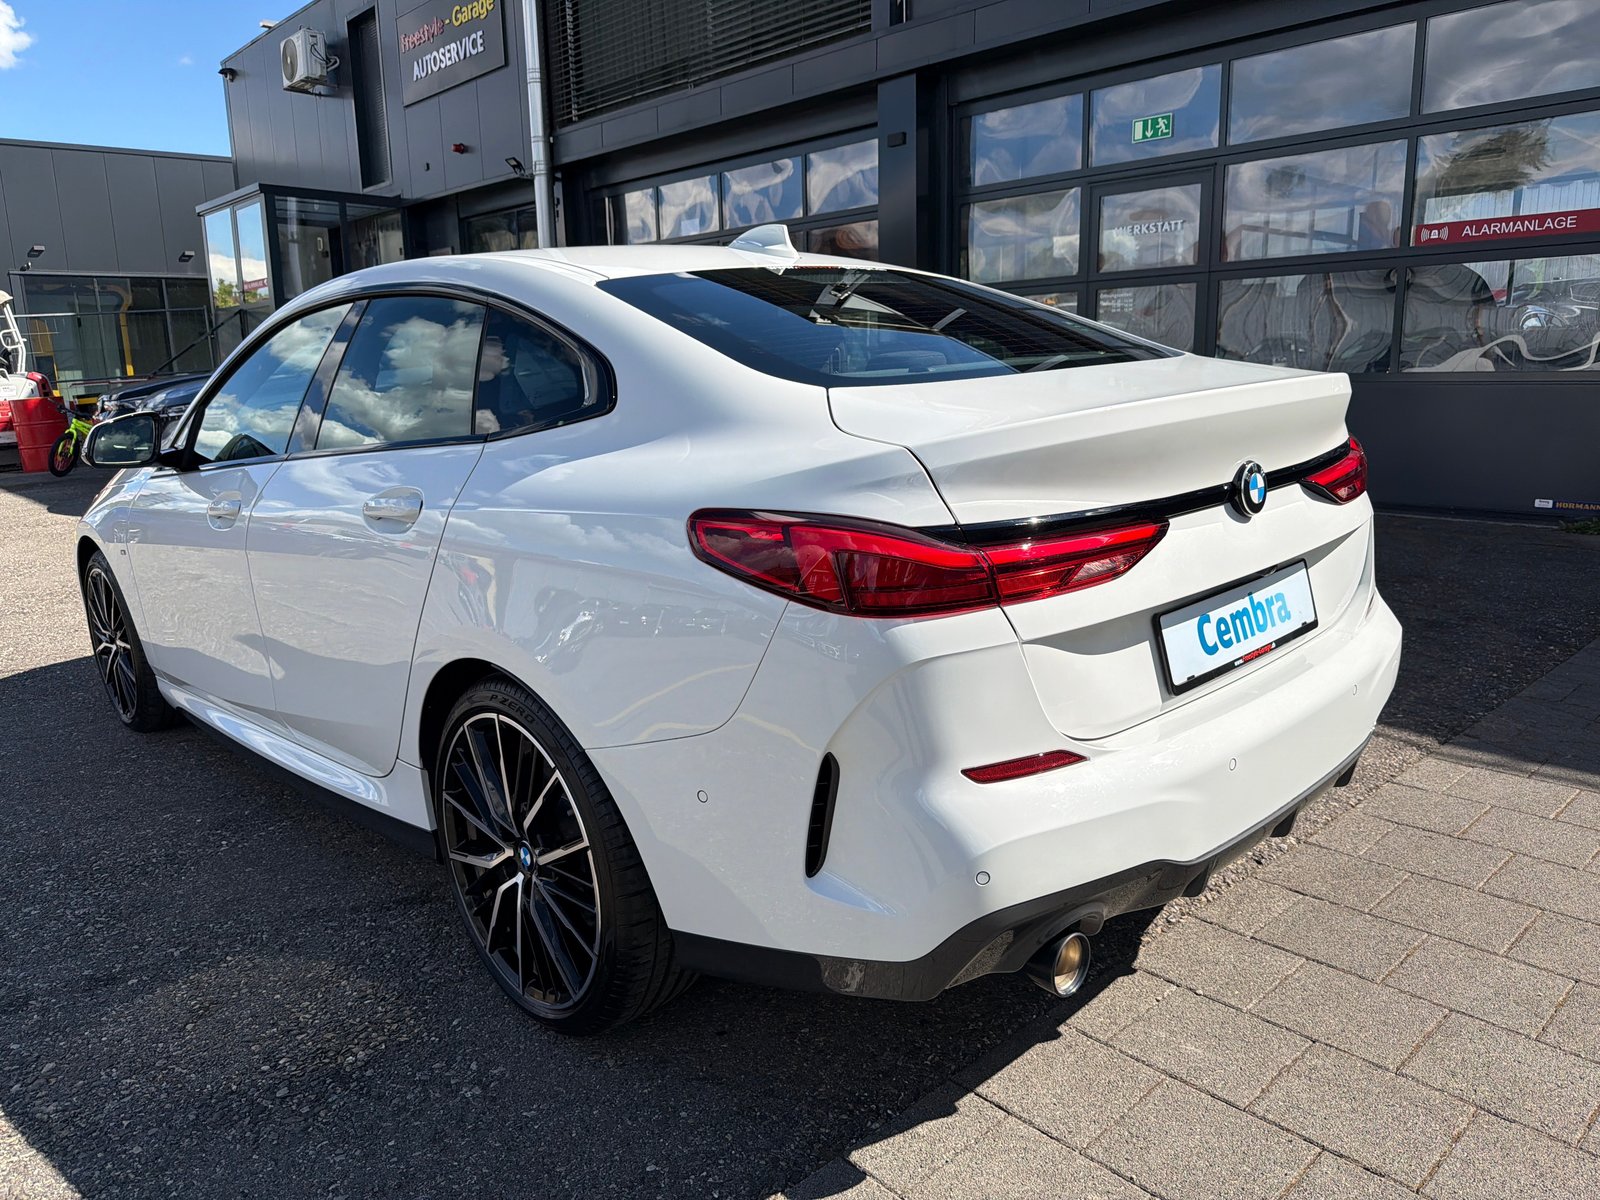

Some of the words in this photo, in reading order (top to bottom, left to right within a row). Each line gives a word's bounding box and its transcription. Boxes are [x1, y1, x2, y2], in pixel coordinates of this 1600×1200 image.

[401, 17, 445, 53] Freestyle
[452, 0, 494, 27] Garage
[413, 30, 484, 82] AUTOSERVICE
[1113, 219, 1184, 238] WERKSTATT
[1461, 216, 1578, 237] ALARMANLAGE
[1196, 592, 1291, 656] Cembra
[499, 697, 536, 723] ZERO
